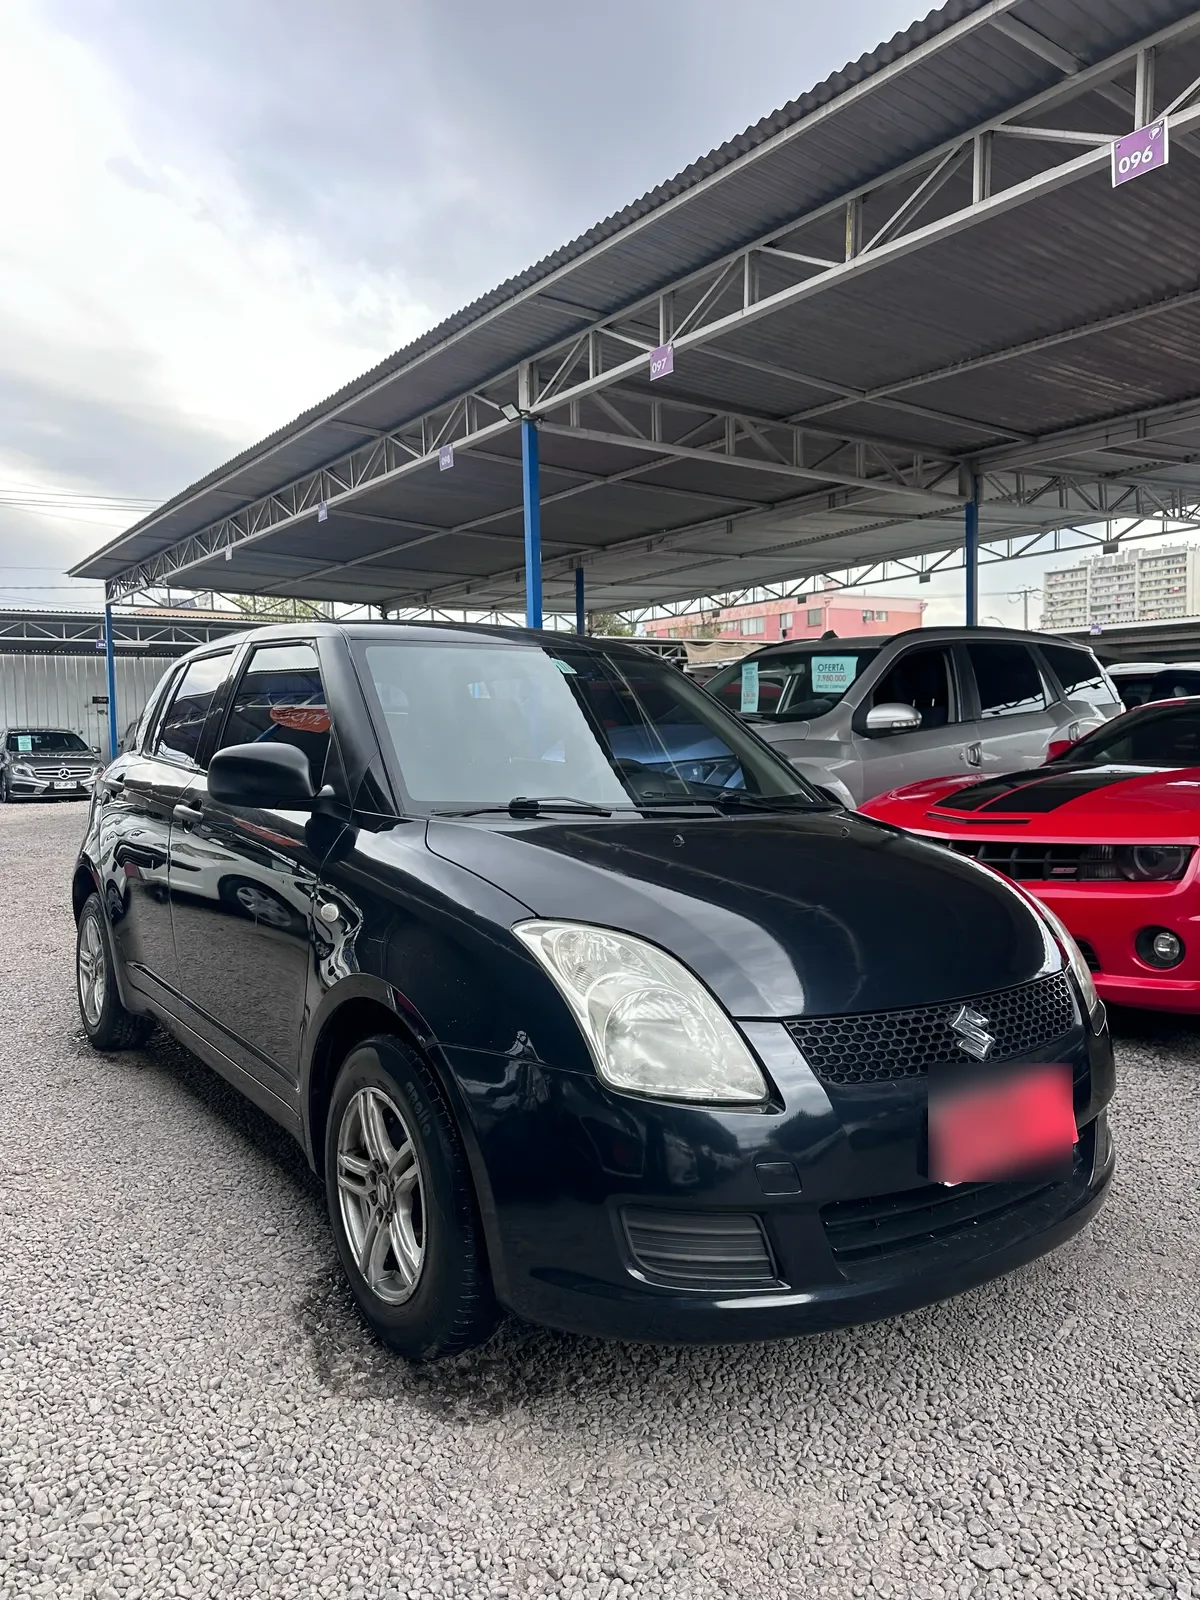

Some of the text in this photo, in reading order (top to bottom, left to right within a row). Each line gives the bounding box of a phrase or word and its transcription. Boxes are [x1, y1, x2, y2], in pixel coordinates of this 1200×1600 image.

[1118, 144, 1153, 174] 096
[651, 357, 667, 374] 097
[817, 663, 845, 672] OFERTA
[816, 674, 847, 682] 7.980.000
[405, 1082, 431, 1136] apollo
